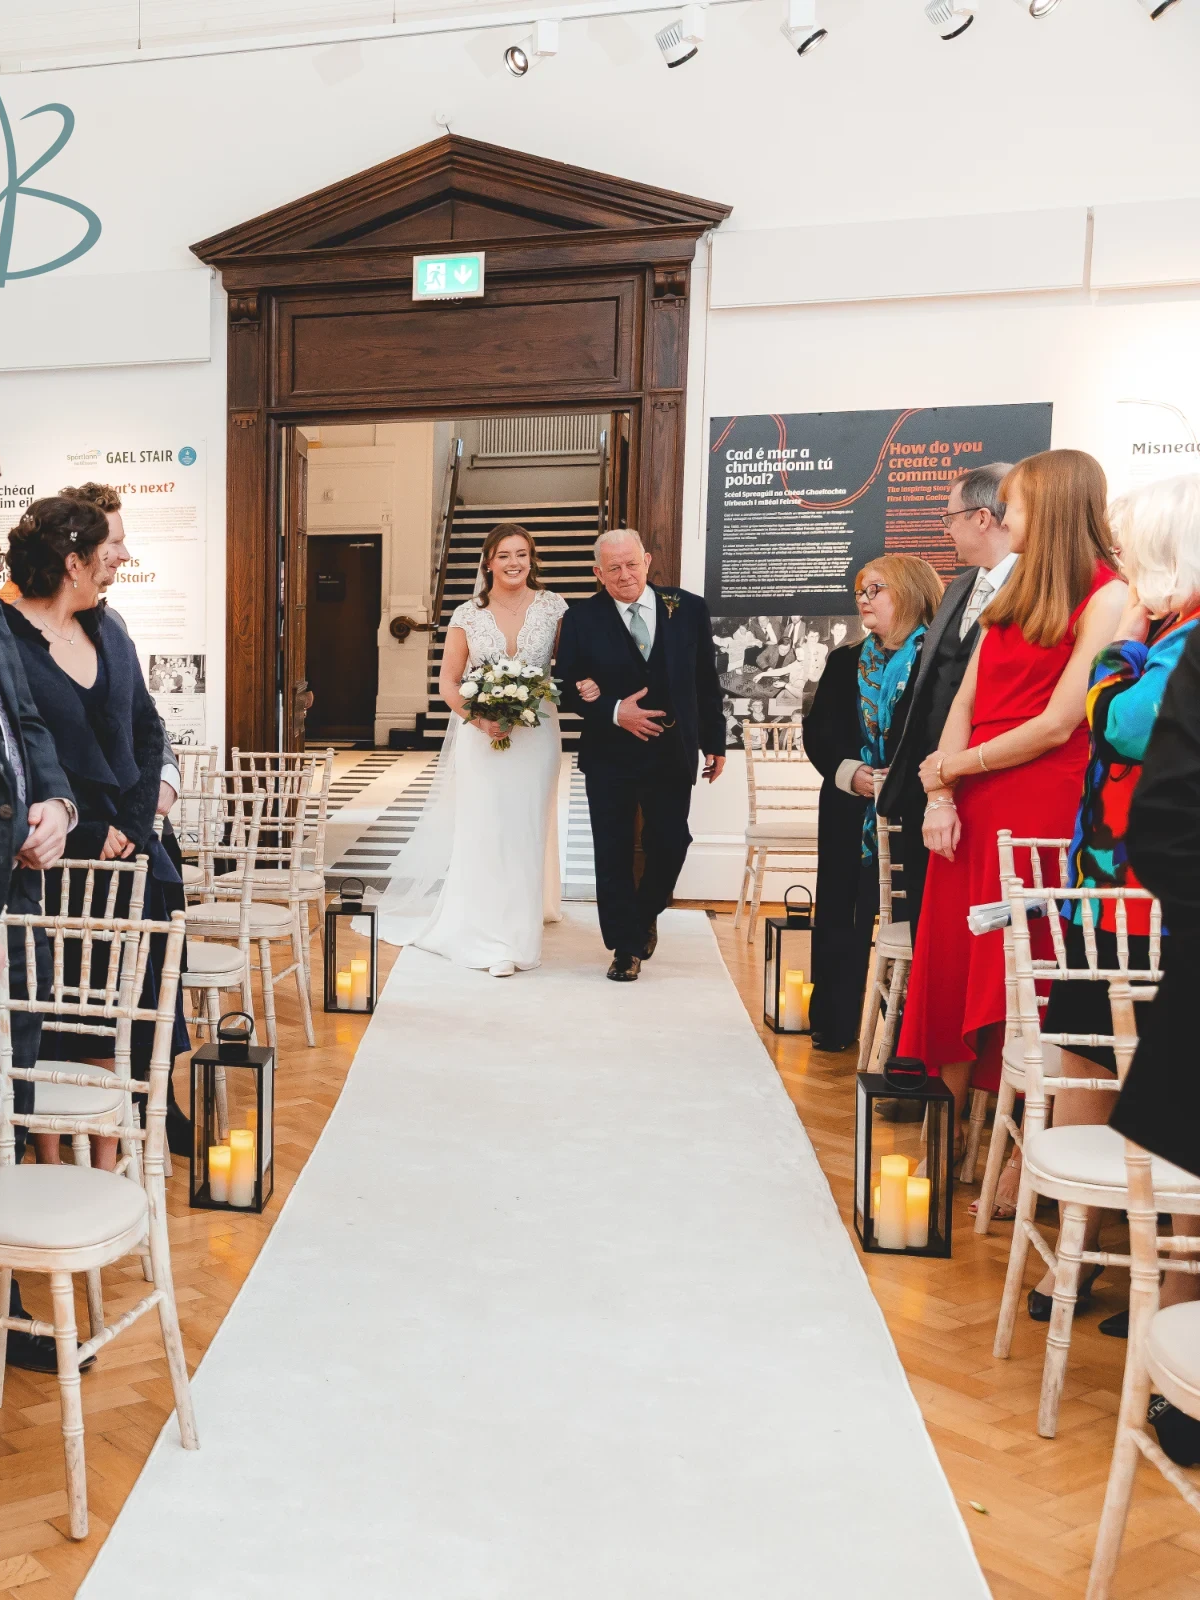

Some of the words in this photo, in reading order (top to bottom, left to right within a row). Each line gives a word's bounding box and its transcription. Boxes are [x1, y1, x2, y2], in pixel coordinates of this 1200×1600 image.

[726, 448, 753, 461] Cad
[755, 447, 765, 460] é
[767, 448, 798, 460] mar
[800, 448, 810, 459] a
[889, 442, 926, 455] How
[929, 440, 950, 454] do
[953, 441, 983, 456] you
[106, 451, 136, 464] GAEL
[139, 450, 173, 463] STAIR
[888, 456, 938, 469] create
[941, 456, 952, 468] a
[725, 459, 814, 473] chruthaíonn
[817, 457, 833, 471] tú
[139, 481, 175, 494] next?
[725, 473, 774, 489] pobal?
[932, 485, 951, 493] Story
[887, 495, 902, 503] First
[130, 556, 140, 568] is
[116, 571, 156, 583] lStair?
